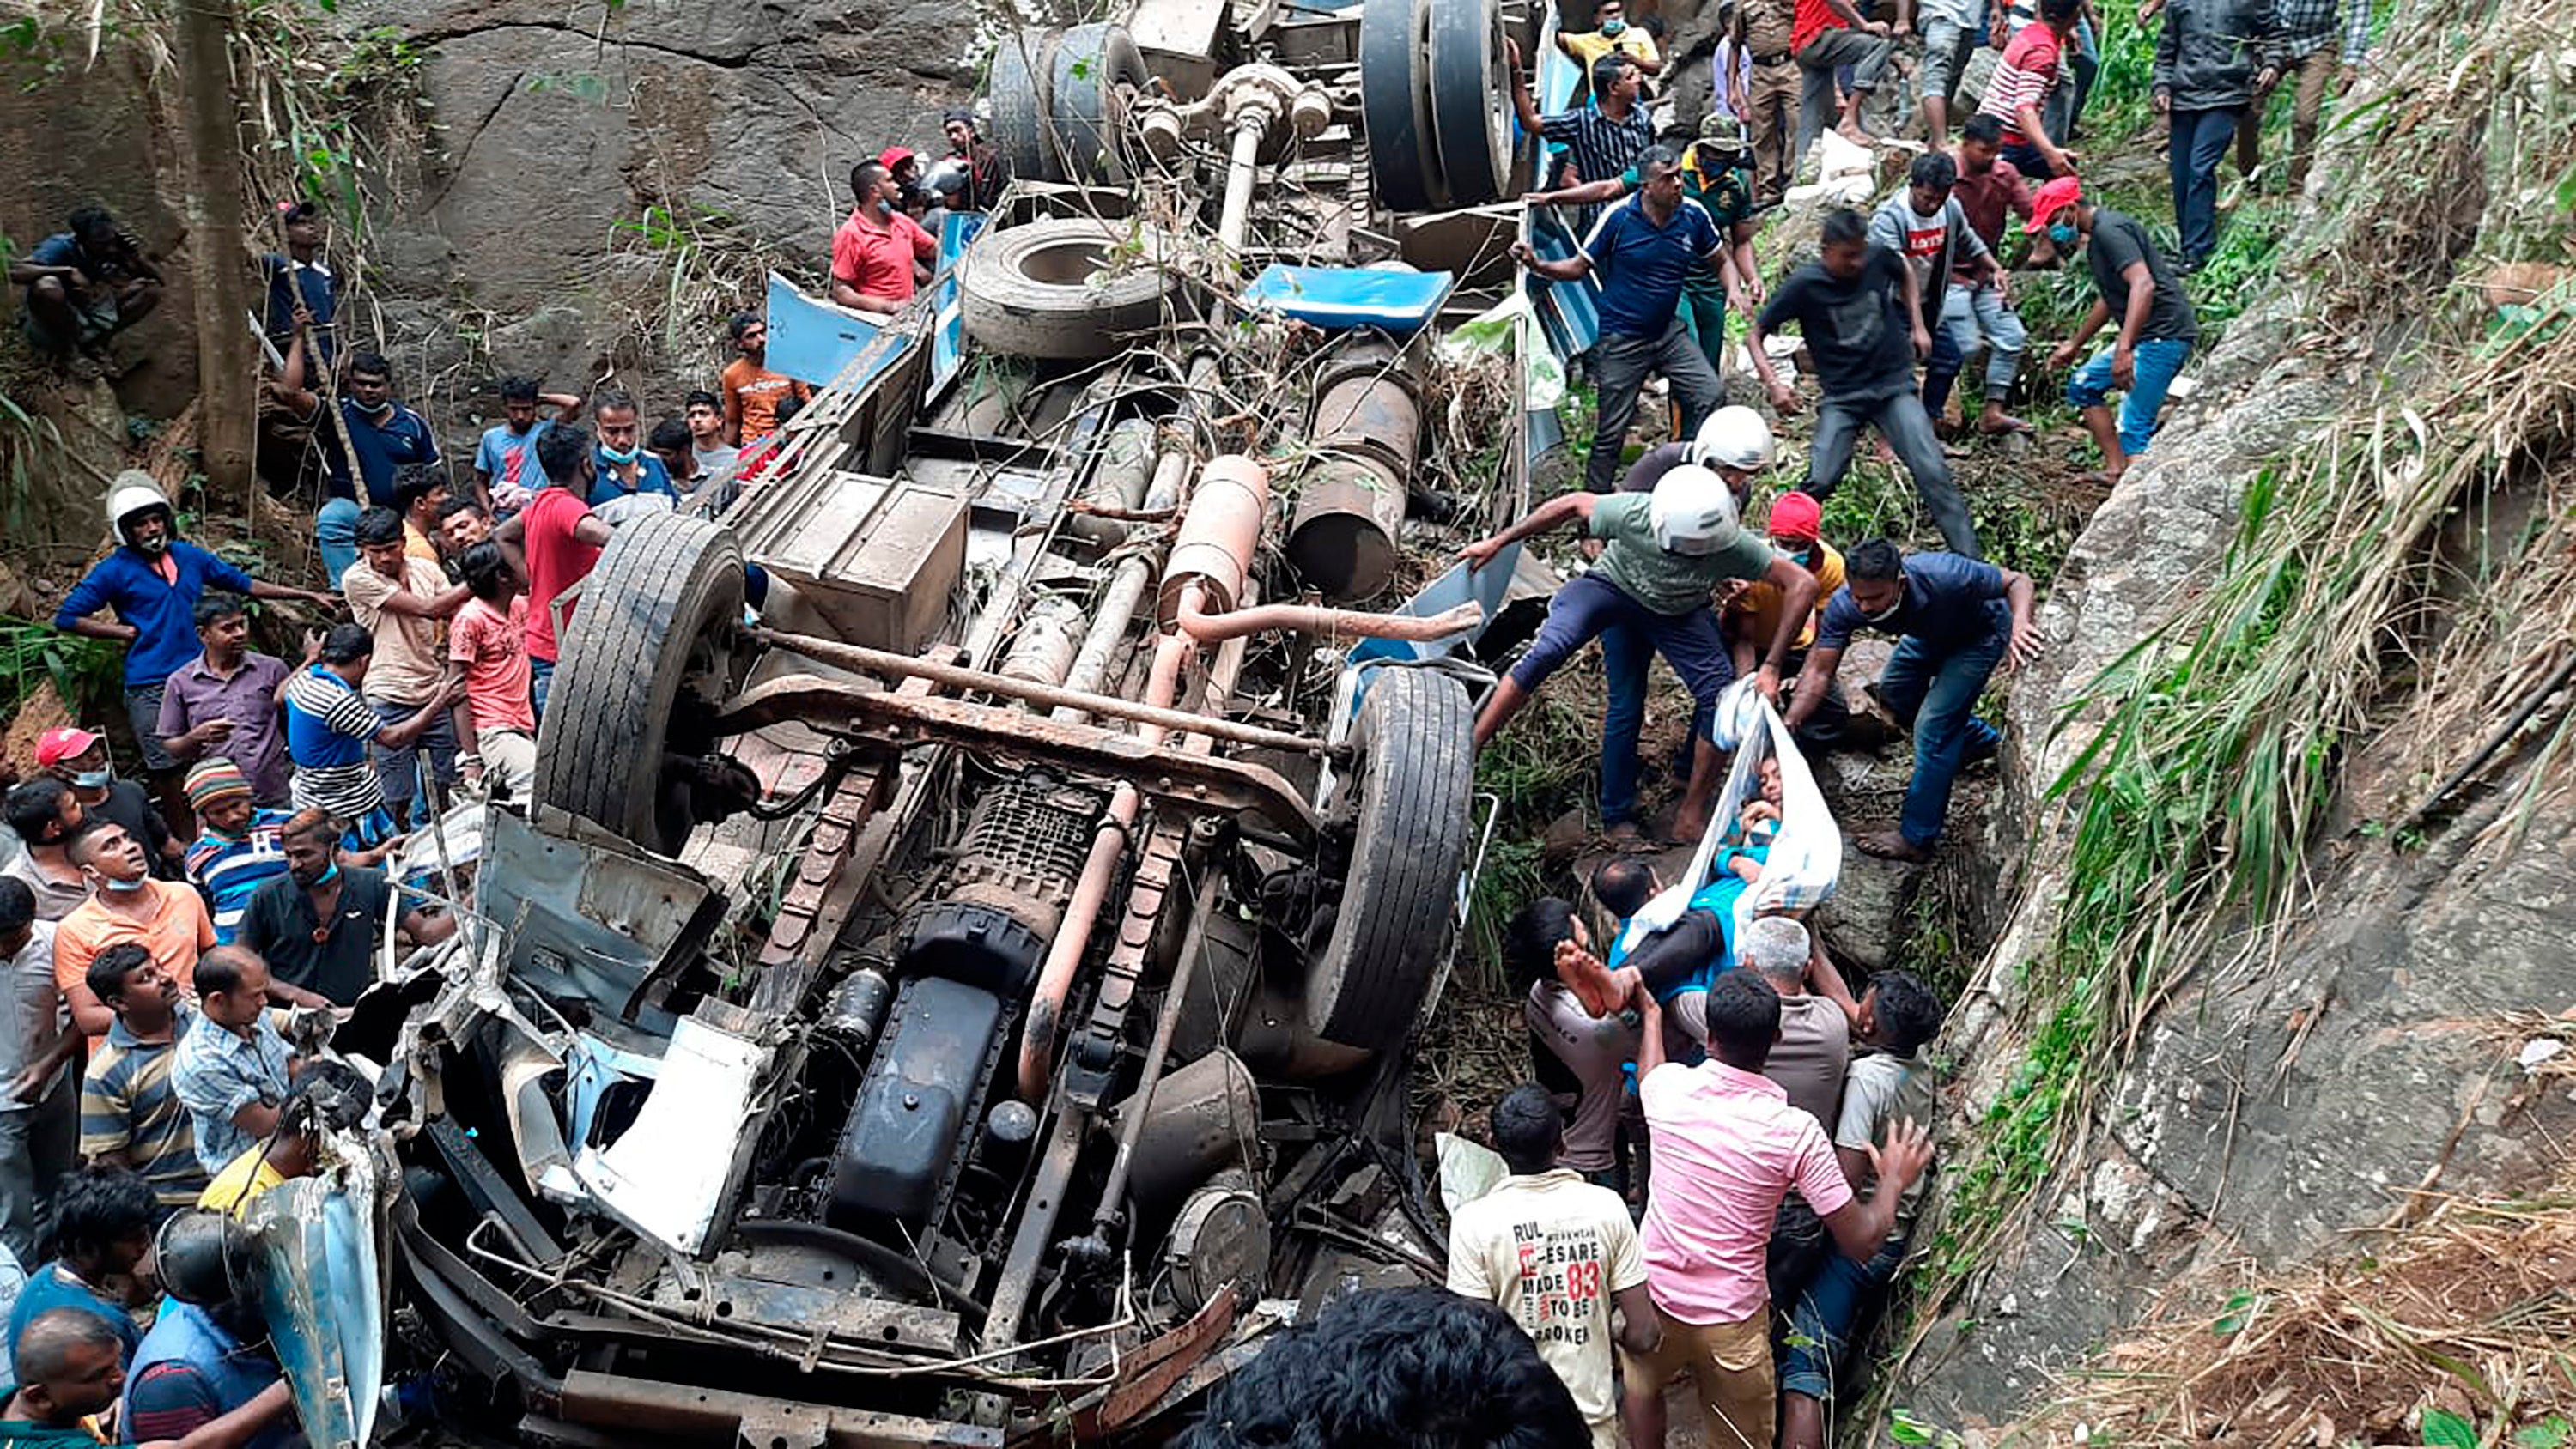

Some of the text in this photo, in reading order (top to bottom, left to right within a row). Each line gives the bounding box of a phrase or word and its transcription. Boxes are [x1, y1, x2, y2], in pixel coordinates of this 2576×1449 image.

[1513, 1221, 1543, 1242] RUL
[1522, 1274, 1564, 1294] MADE
[1567, 1261, 1600, 1300] 83
[1551, 1300, 1569, 1316] TO
[1574, 1298, 1589, 1318] BE
